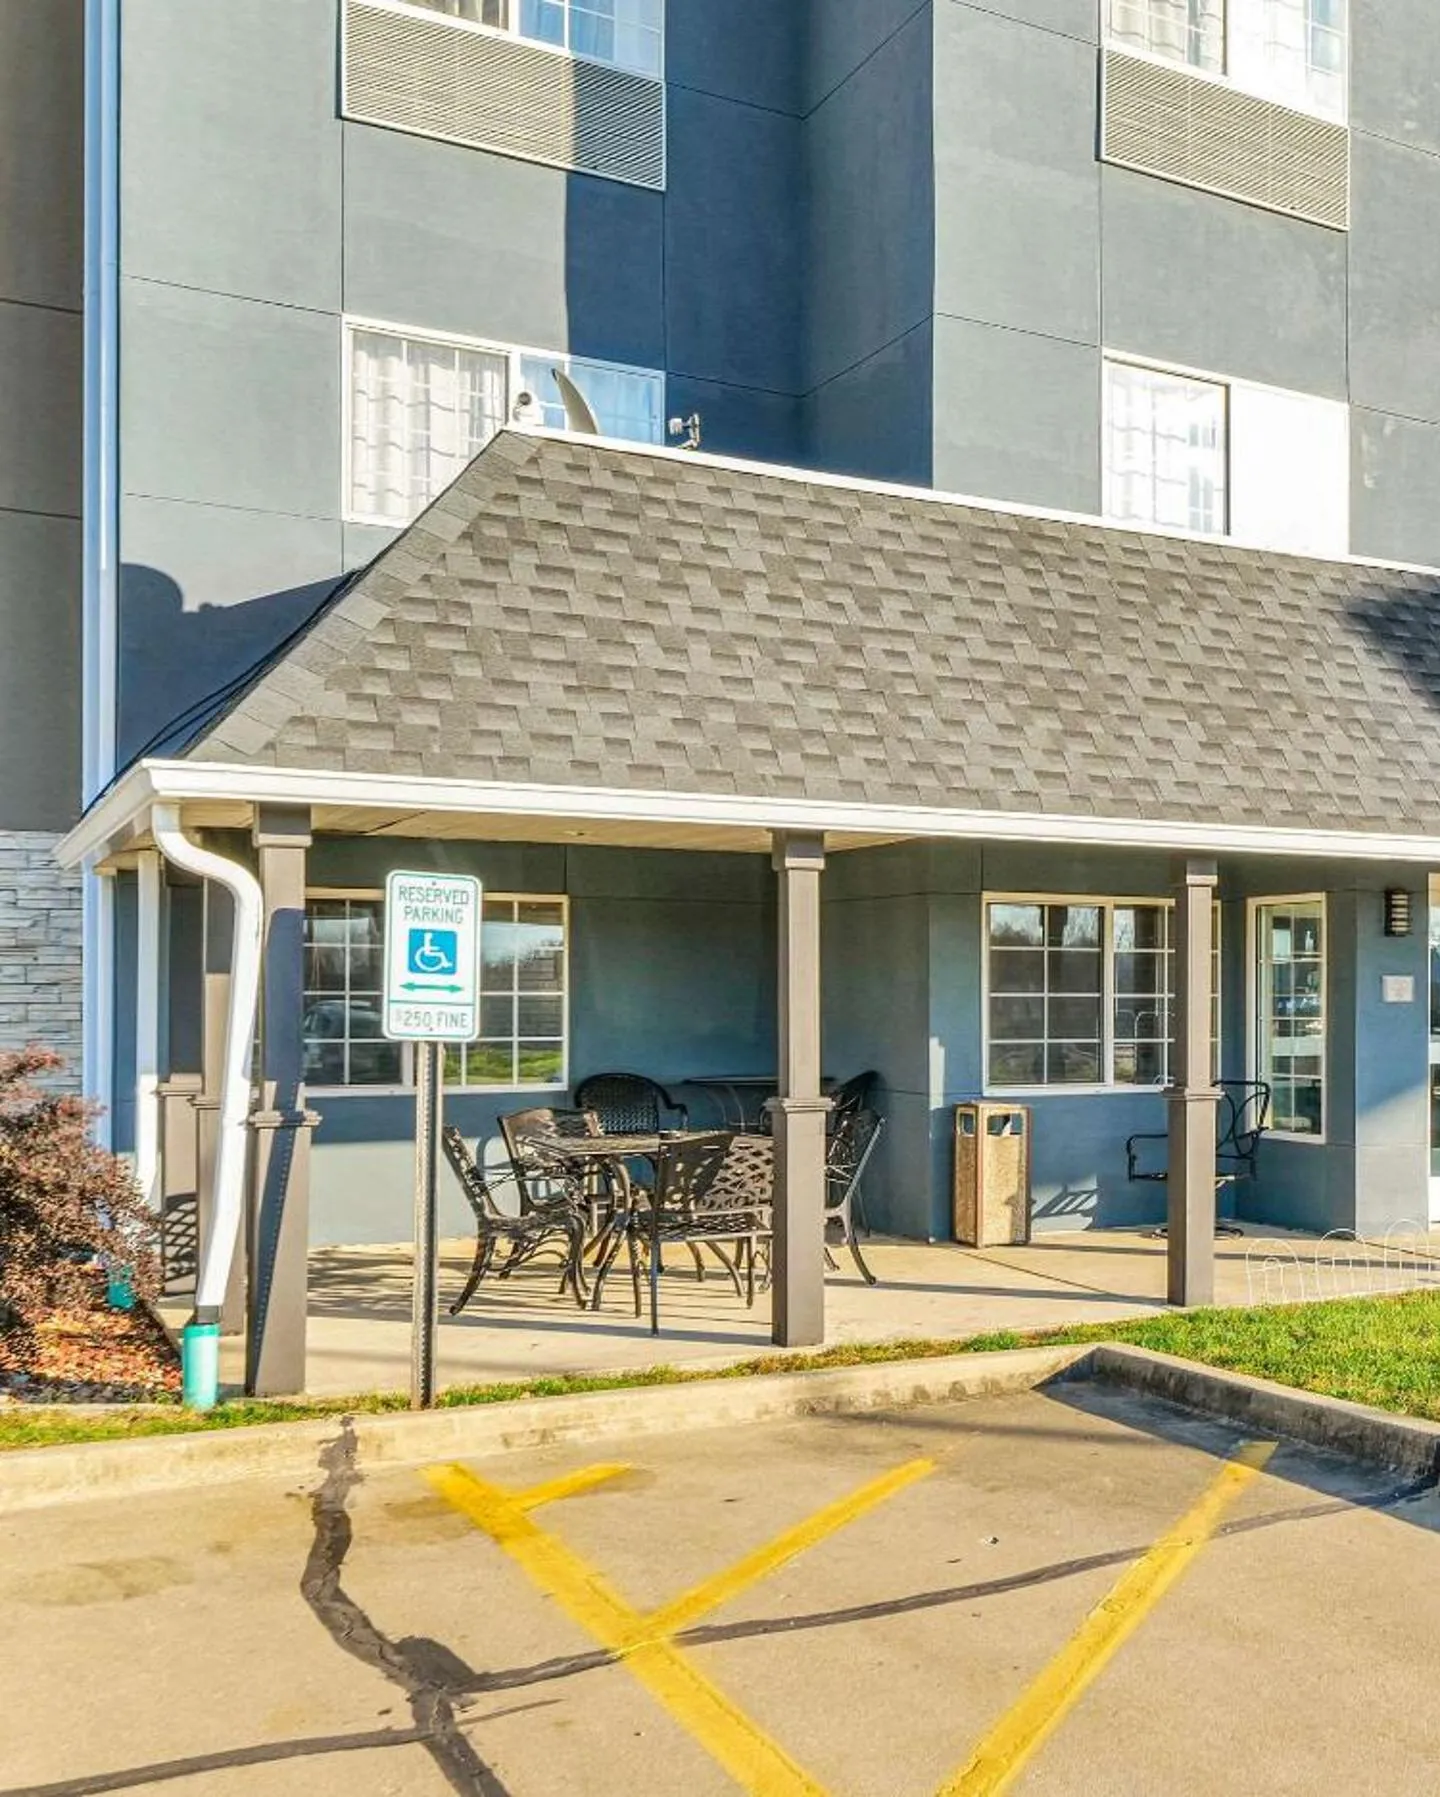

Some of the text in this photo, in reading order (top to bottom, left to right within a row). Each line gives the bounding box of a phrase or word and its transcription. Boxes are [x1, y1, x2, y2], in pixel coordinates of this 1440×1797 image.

[399, 885, 470, 905] RESERVED
[403, 905, 464, 924] PARKING
[436, 1010, 468, 1029] FINE
